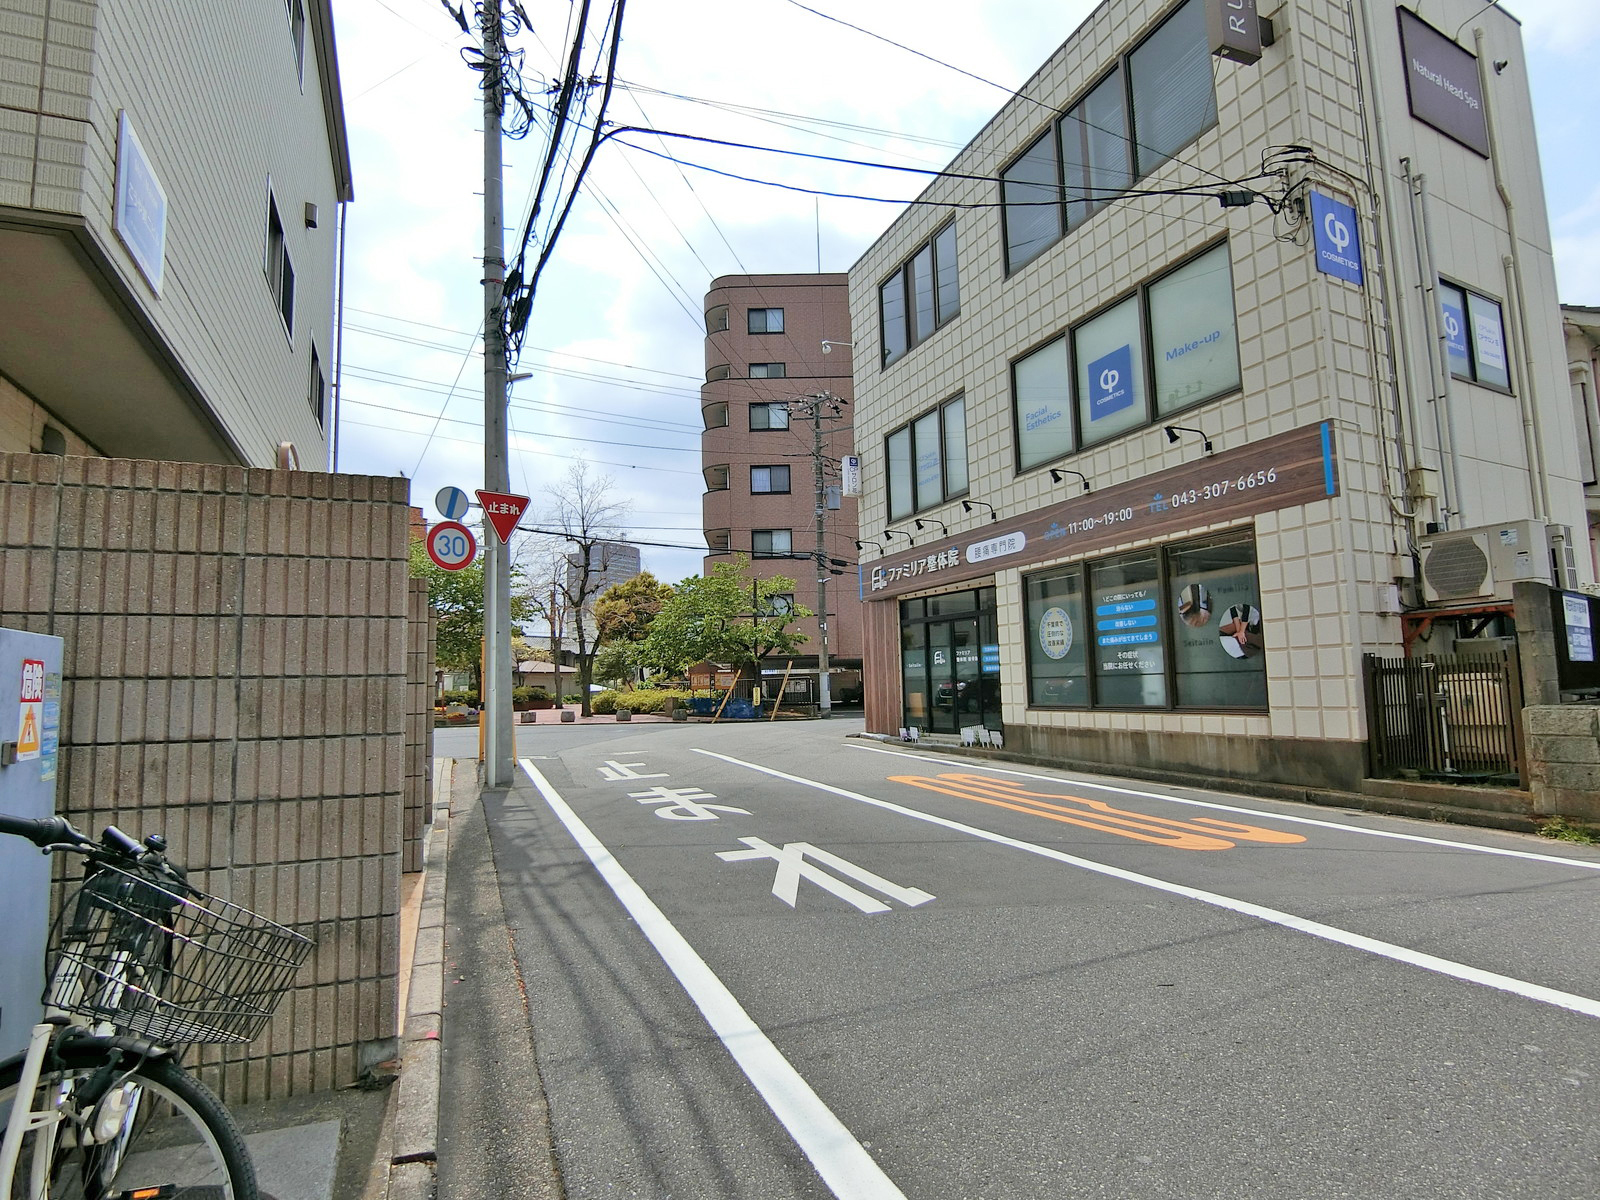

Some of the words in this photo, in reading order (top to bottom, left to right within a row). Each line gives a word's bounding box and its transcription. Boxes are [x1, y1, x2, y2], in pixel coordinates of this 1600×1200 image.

[1412, 57, 1443, 88] Natural
[1443, 76, 1464, 100] Head
[1464, 91, 1479, 110] Spa
[1321, 249, 1359, 271] COSMETICS
[1165, 329, 1221, 362] Make-up
[1096, 388, 1125, 406] COSMETICS
[1025, 405, 1048, 422] Facial
[1026, 410, 1062, 432] Esthetics
[1148, 502, 1169, 513] TEL
[1171, 467, 1277, 508] 043-307-6656
[487, 501, 521, 516] 止まれ
[1043, 528, 1067, 541] OPEN
[438, 535, 465, 558] 30
[888, 548, 960, 582] ファミリア整体院
[1116, 650, 1139, 660] その症状
[21, 663, 43, 700] 危険
[597, 759, 937, 914] 止まれ
